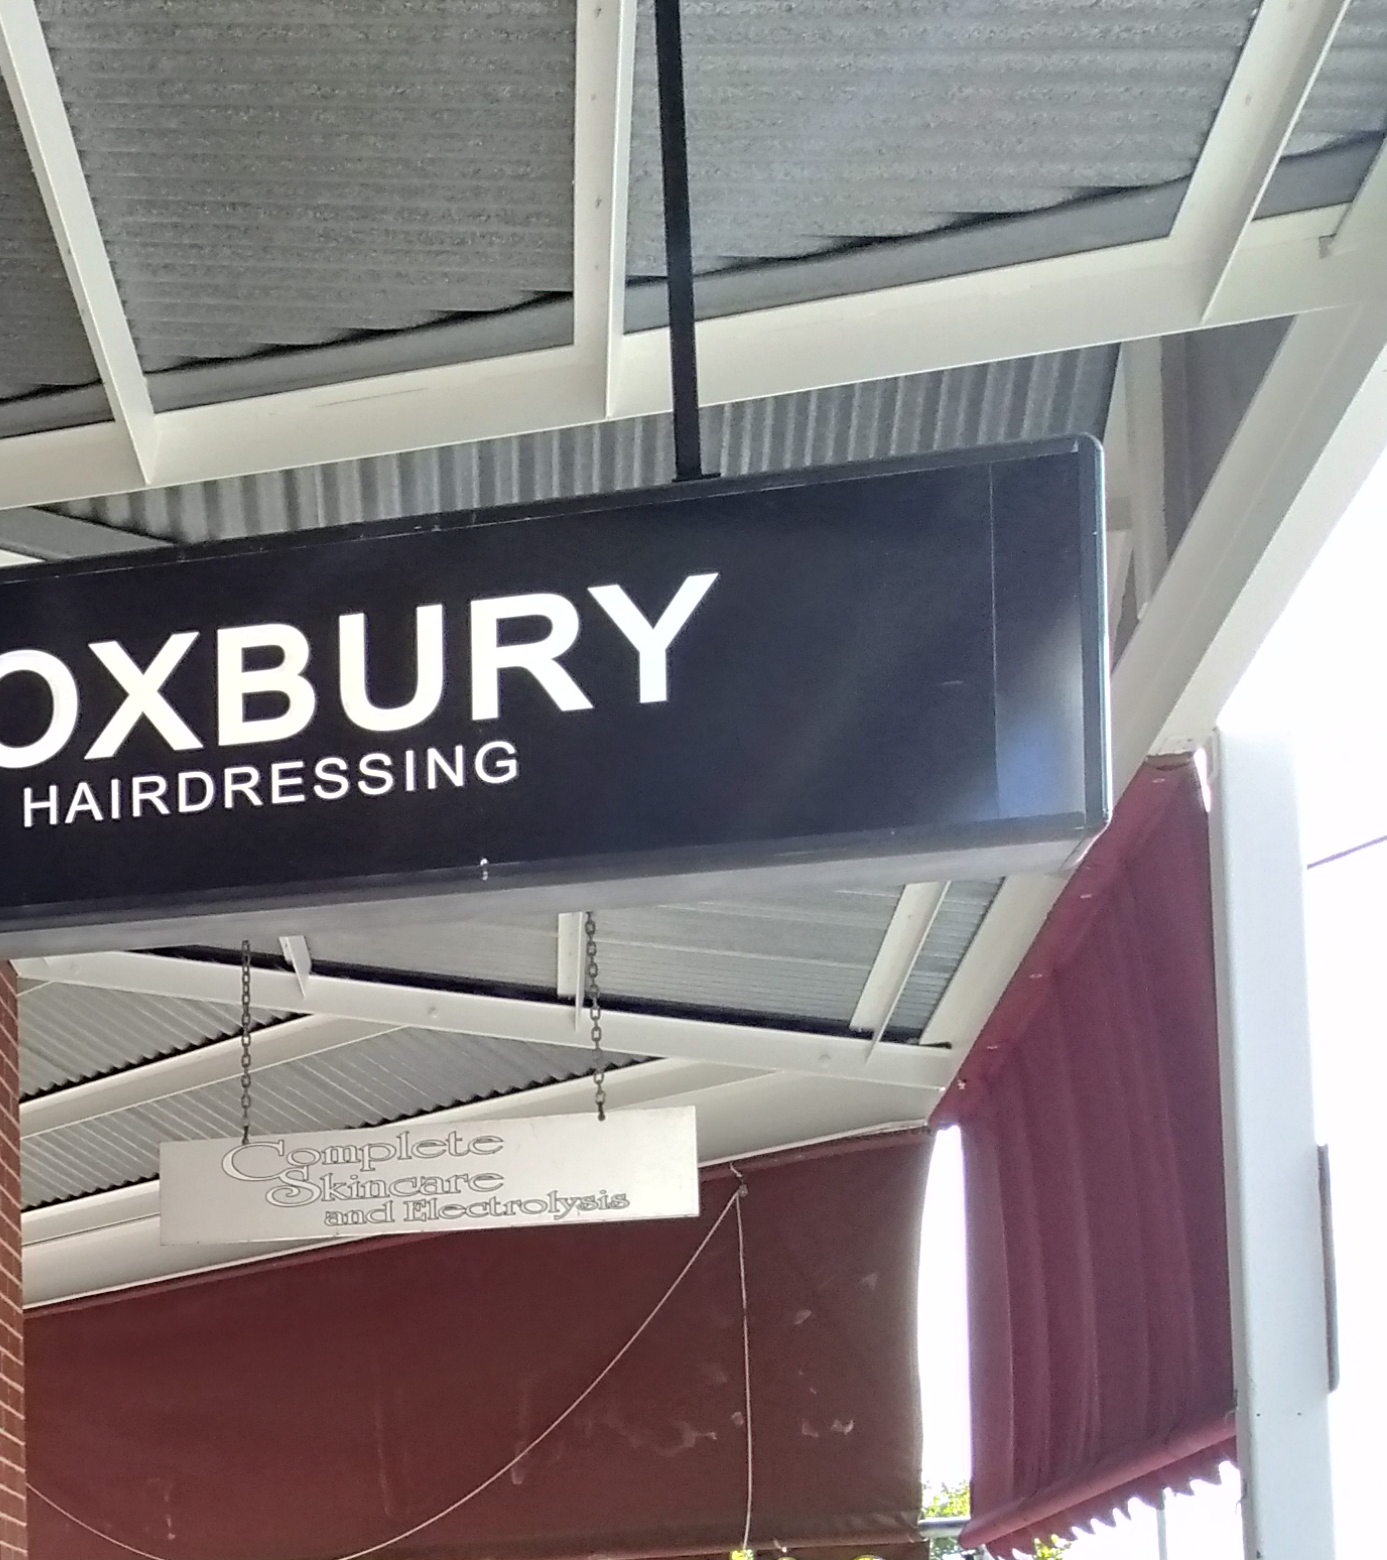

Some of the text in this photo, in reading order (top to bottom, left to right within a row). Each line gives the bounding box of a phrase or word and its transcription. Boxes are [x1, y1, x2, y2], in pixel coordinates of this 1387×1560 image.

[23, 740, 520, 828] HAIRDRESSING
[221, 1130, 504, 1182] Complete
[264, 1165, 504, 1208] Skincare
[324, 1190, 631, 1227] and Electrolysis
